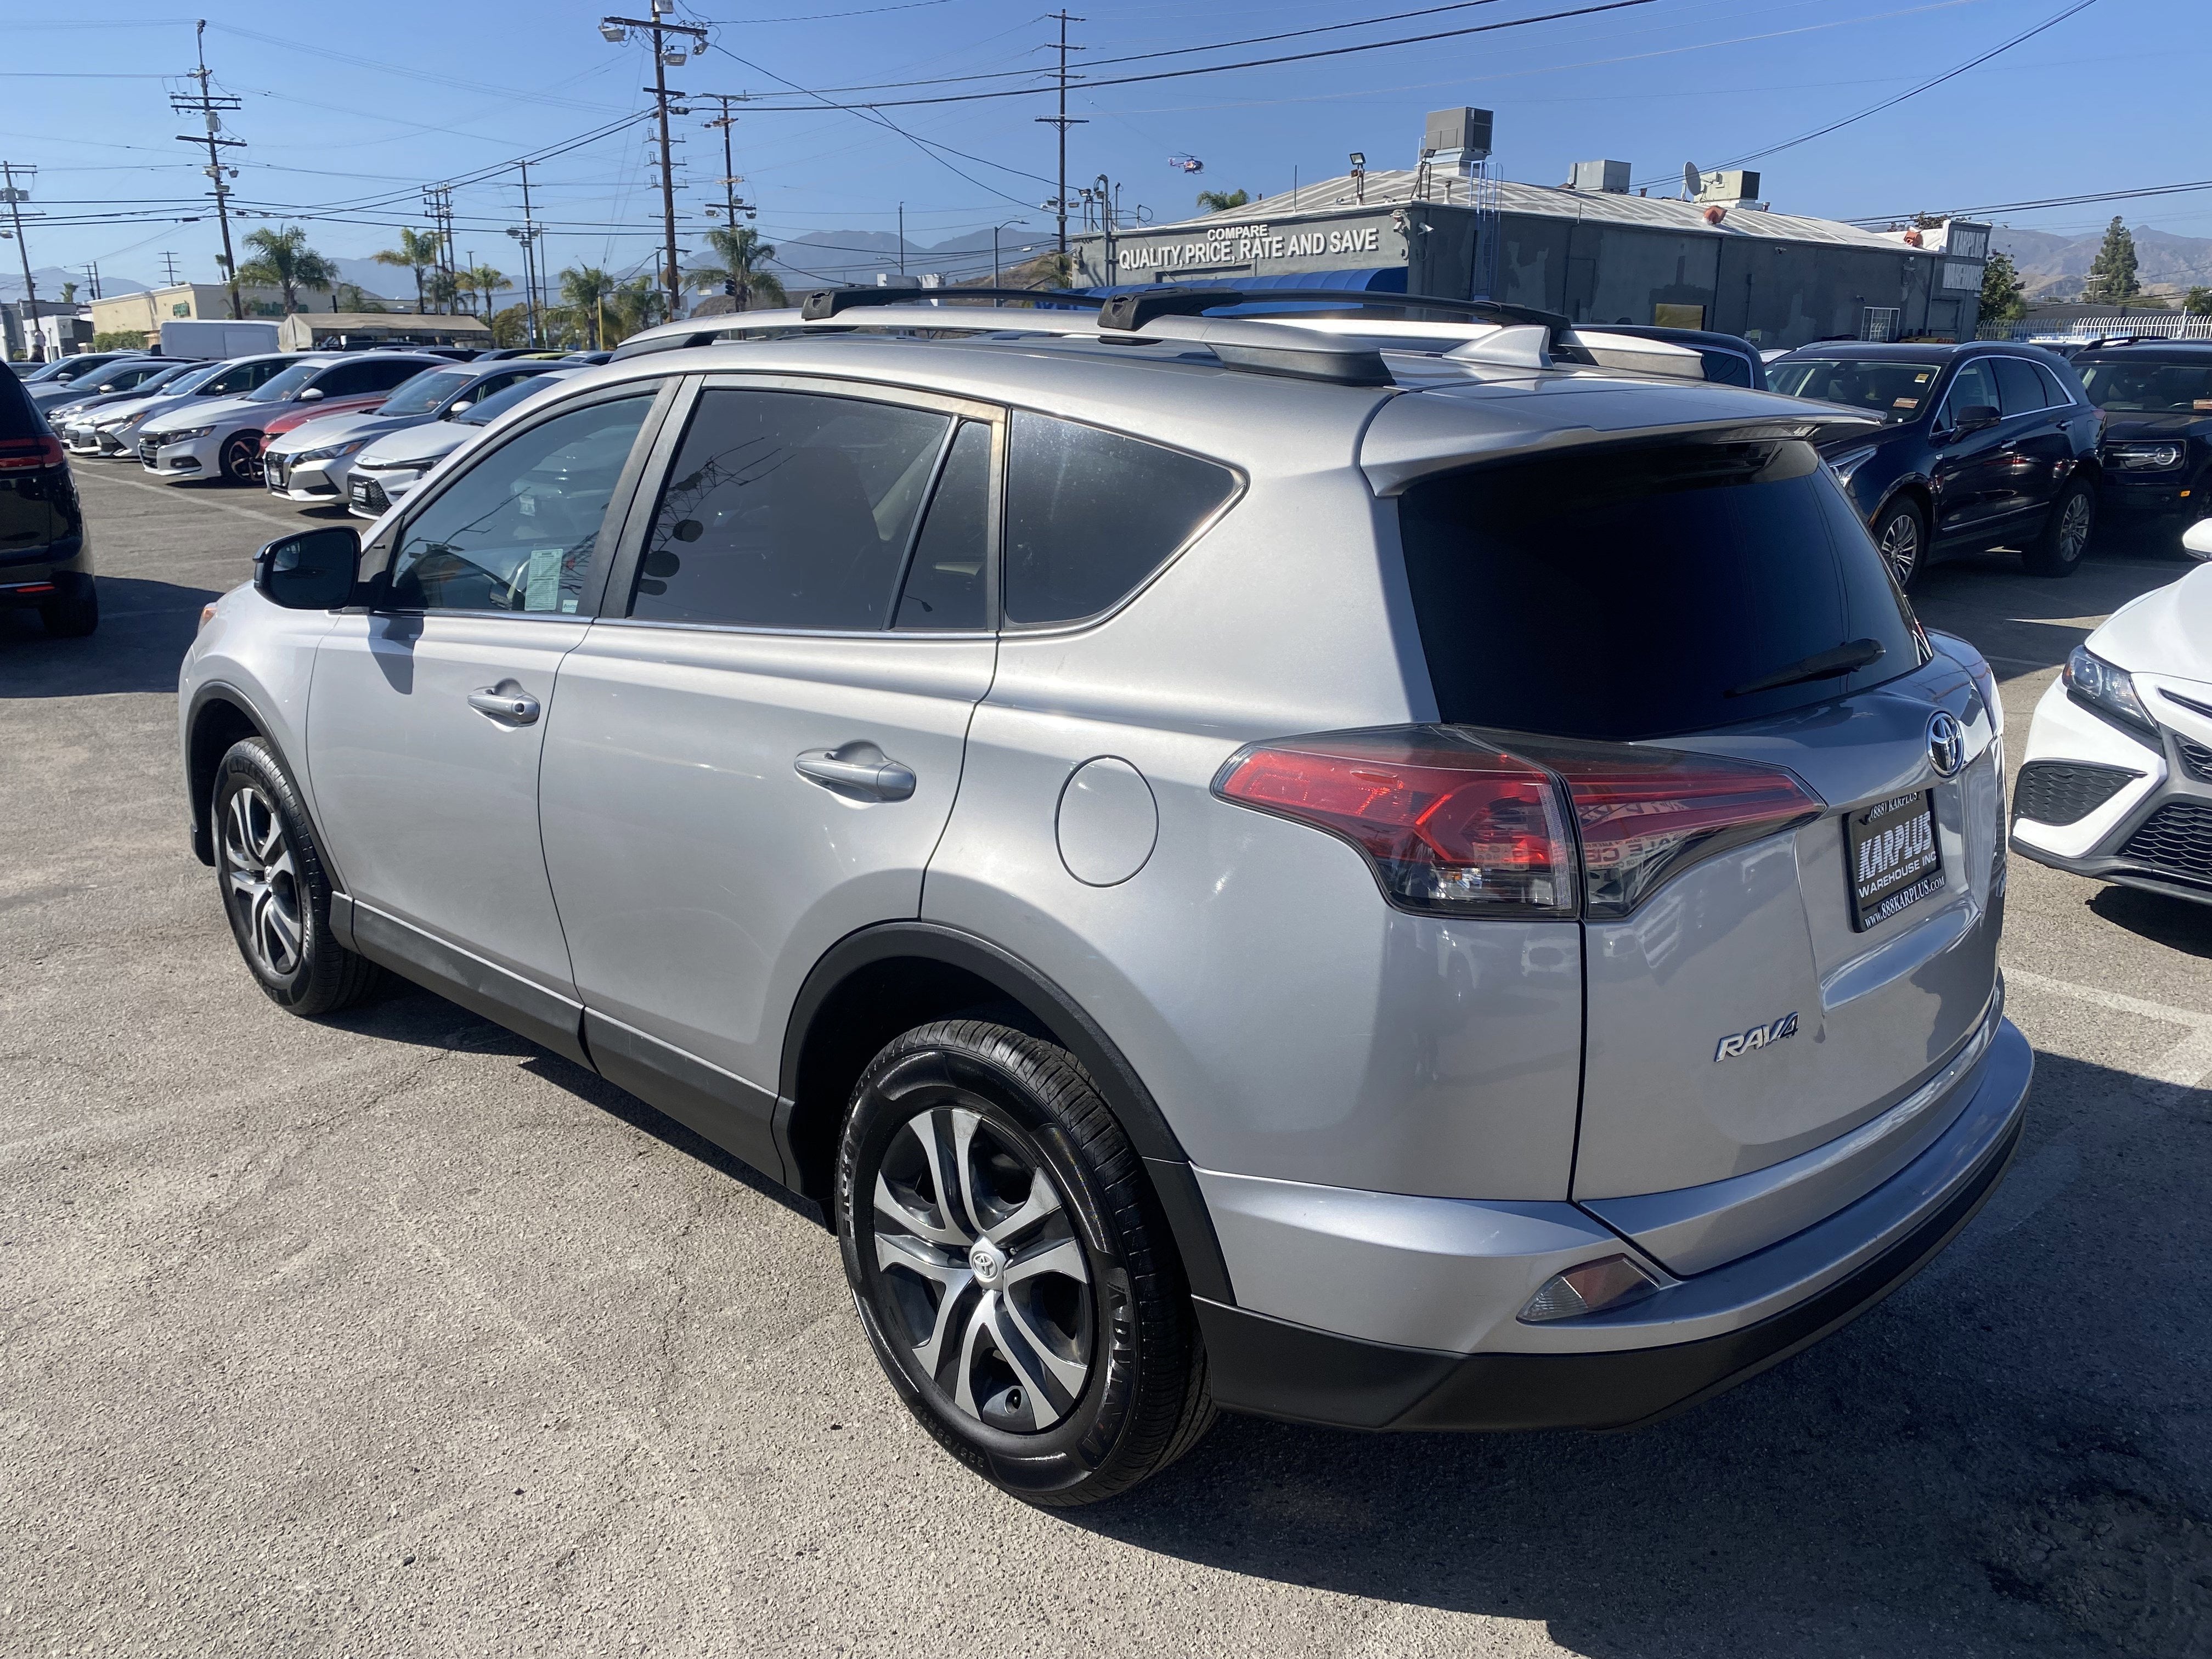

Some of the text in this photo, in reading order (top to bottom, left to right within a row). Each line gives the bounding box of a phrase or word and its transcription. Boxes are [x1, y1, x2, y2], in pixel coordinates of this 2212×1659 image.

[1119, 228, 1378, 270] QUALITY, PRICE, RATE AND SAVE
[1207, 224, 1268, 241] COMPARE
[1870, 802, 1887, 819] (888)
[1858, 810, 1932, 882] KARPLUS
[1858, 859, 1920, 898] WAREHOUSE
[1714, 1011, 1799, 1062] RAV4
